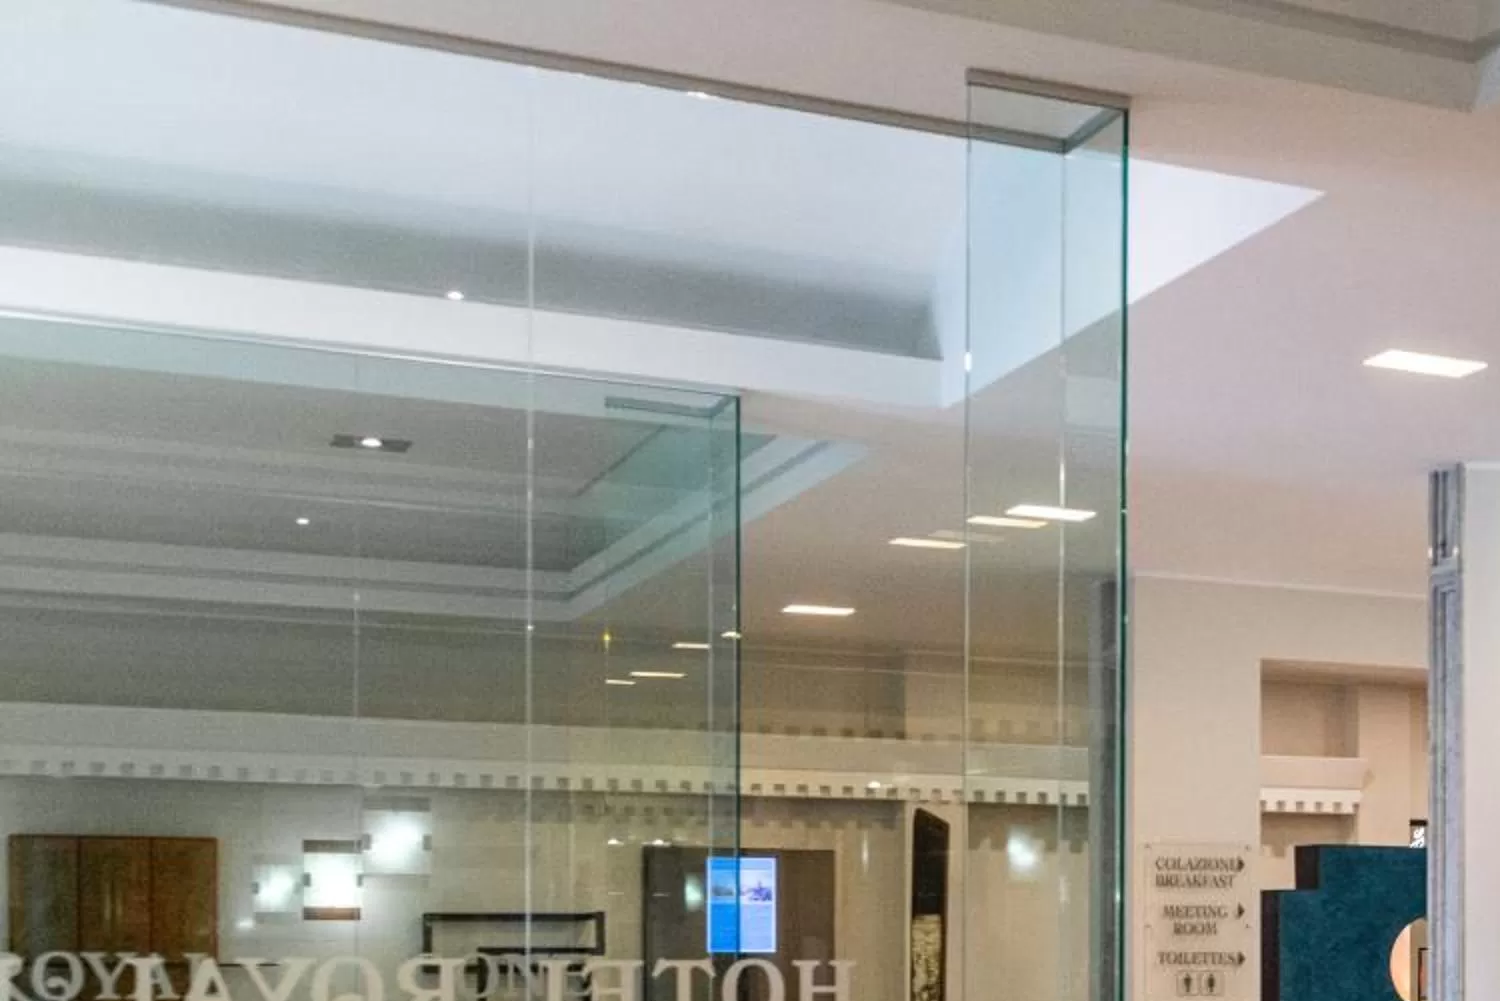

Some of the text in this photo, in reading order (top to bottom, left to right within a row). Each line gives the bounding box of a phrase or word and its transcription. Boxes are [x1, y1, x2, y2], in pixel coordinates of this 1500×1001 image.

[1155, 856, 1238, 872] COLAZIONE
[1155, 874, 1235, 888] BREAKFAST
[1162, 904, 1229, 919] MEETING
[1173, 922, 1218, 936] ROOM
[1157, 952, 1237, 966] TOILETTES
